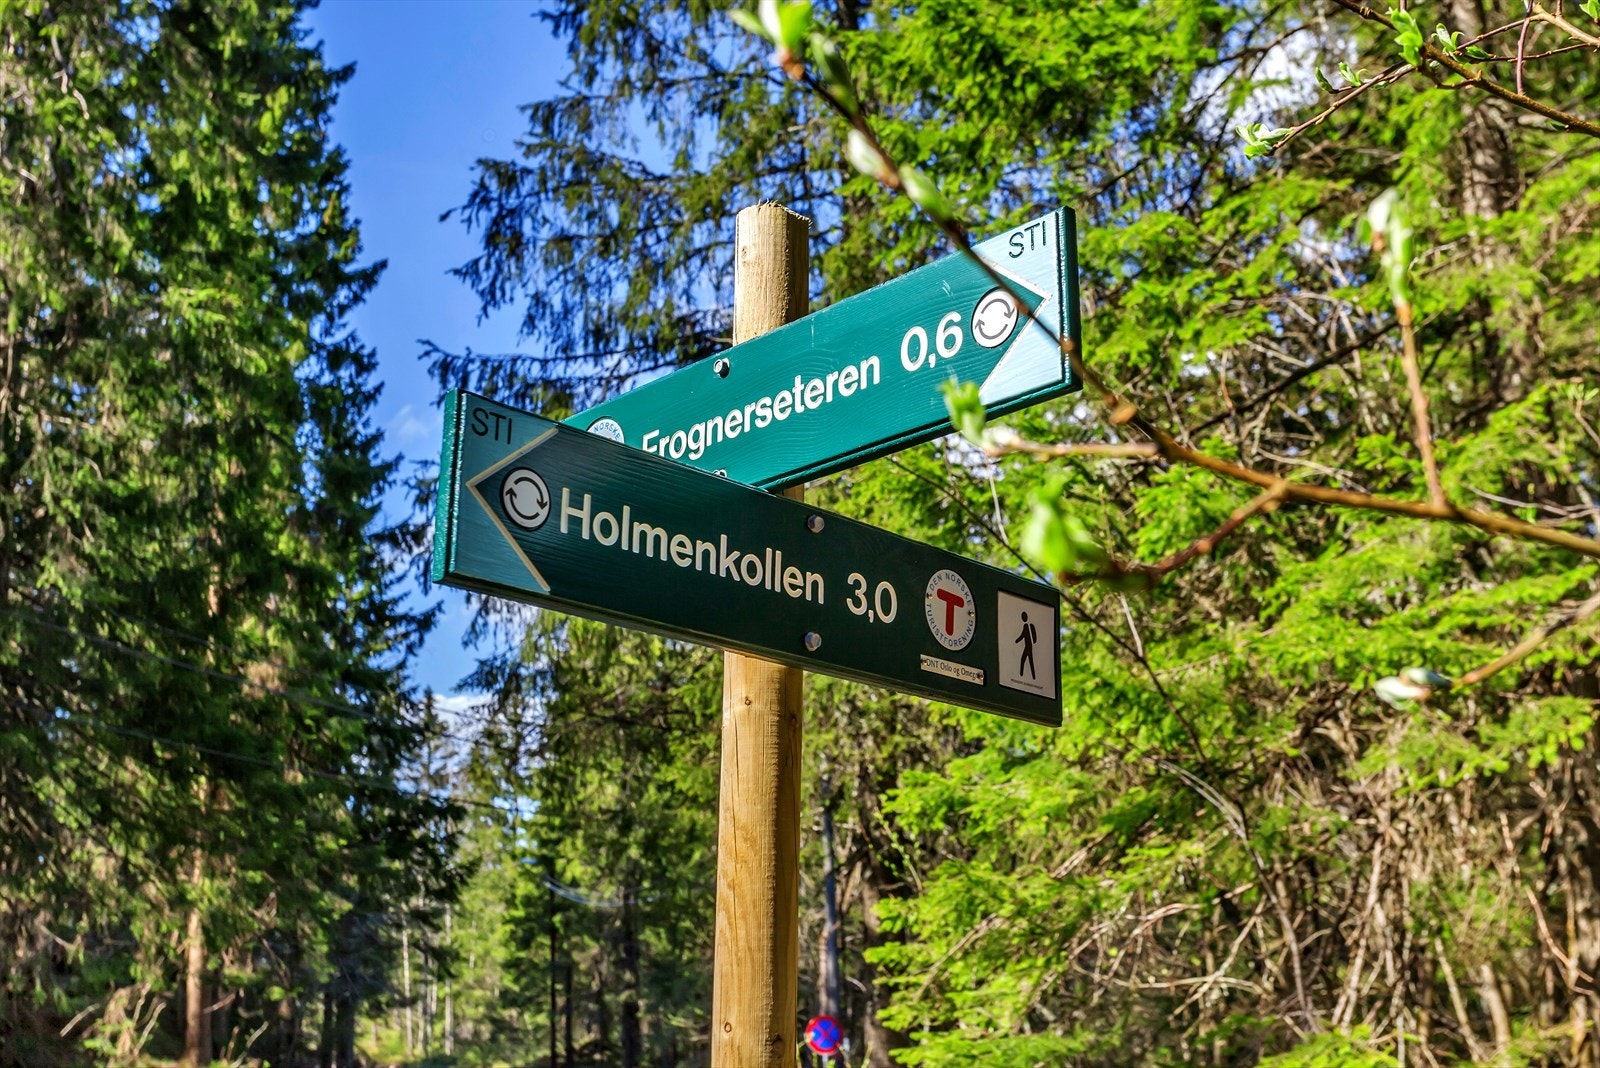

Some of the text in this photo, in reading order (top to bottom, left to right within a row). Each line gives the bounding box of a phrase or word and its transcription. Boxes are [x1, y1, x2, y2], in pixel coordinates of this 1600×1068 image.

[1008, 221, 1047, 258] STI
[642, 311, 963, 460] Frognerseteren 0,6
[471, 407, 513, 445] STI
[594, 422, 621, 440] NORSKE
[560, 487, 898, 624] Holmenkollen 3,0
[929, 572, 972, 606] DEN NORSKE
[926, 603, 974, 647] TURISTFORENING
[936, 588, 965, 636] T
[940, 661, 953, 673] Oslo
[953, 667, 960, 676] og
